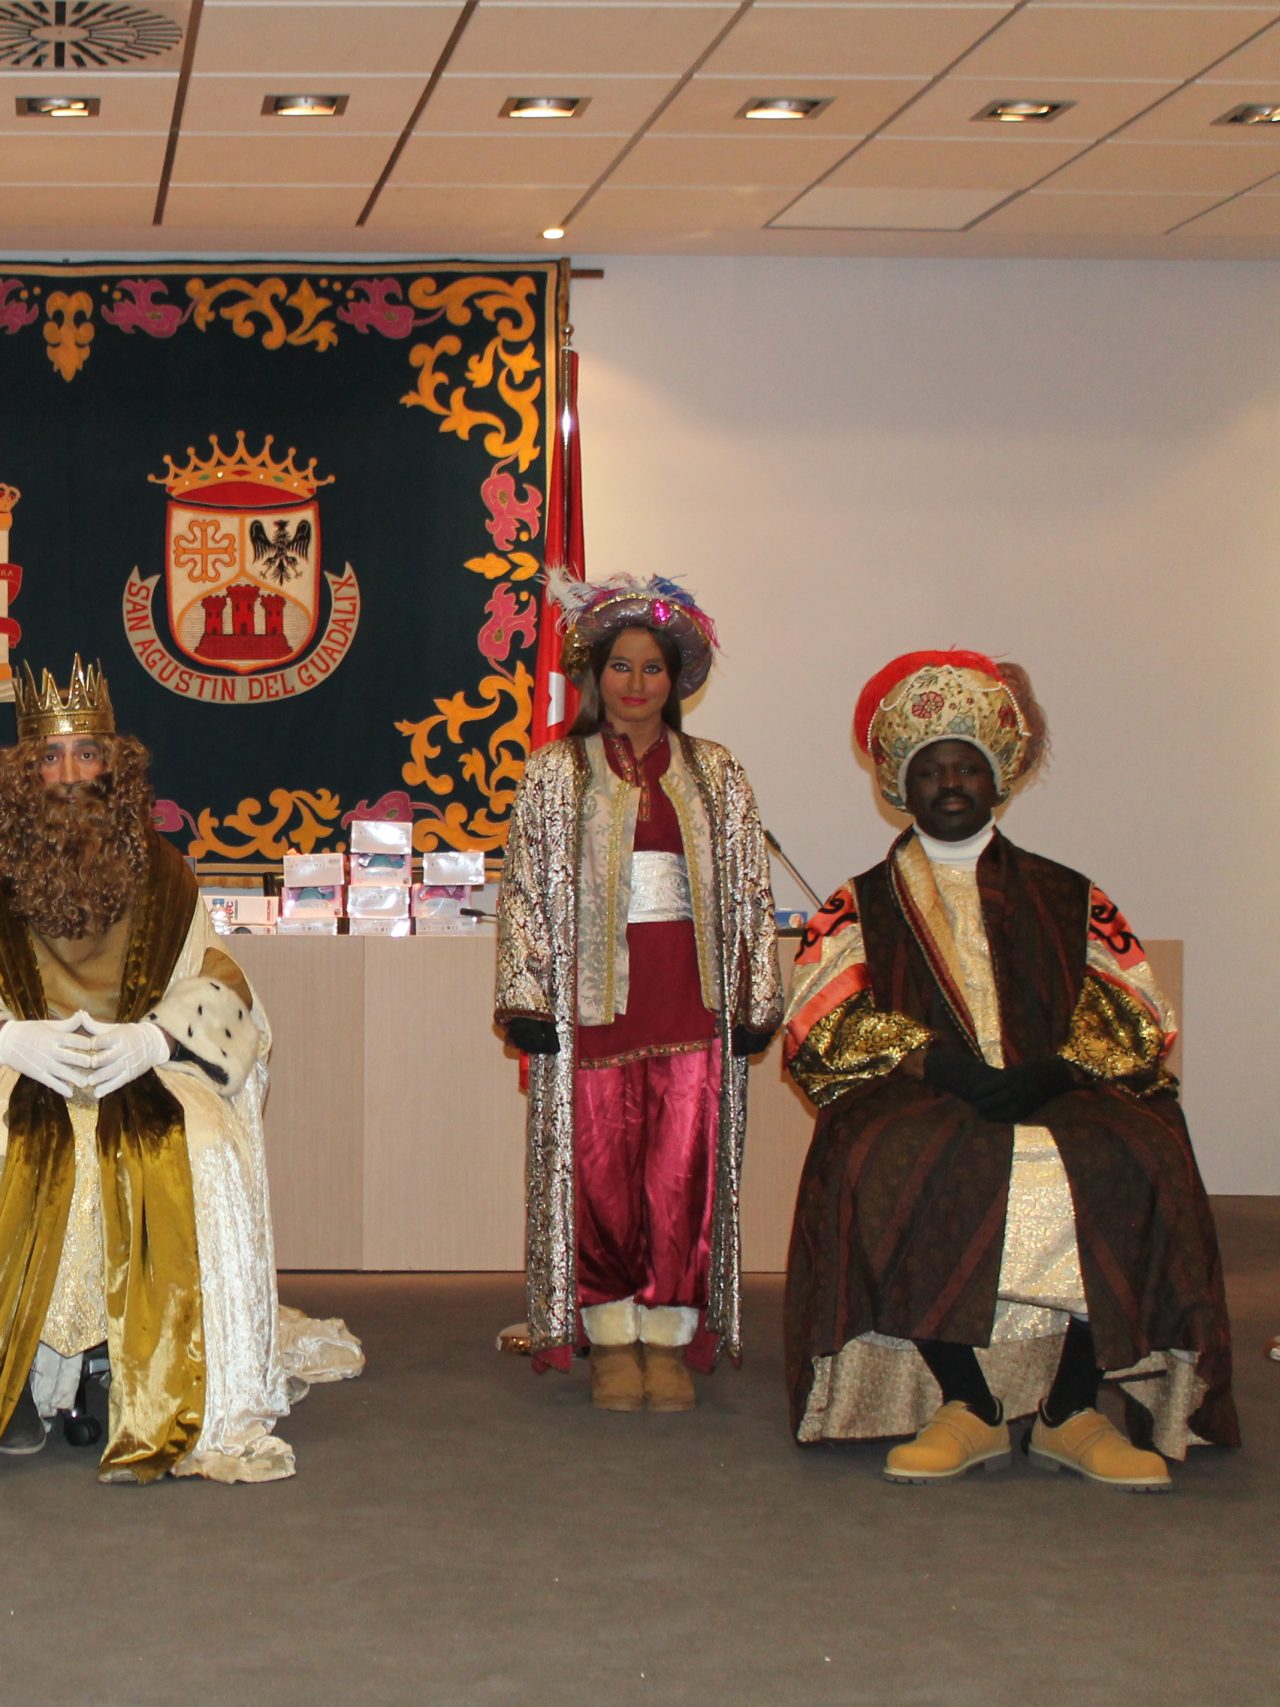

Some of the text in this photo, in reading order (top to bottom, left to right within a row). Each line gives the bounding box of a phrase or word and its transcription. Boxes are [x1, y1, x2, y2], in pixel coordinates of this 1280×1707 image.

[126, 574, 357, 701] SAN AGUSTIN DEL GUADALIX
